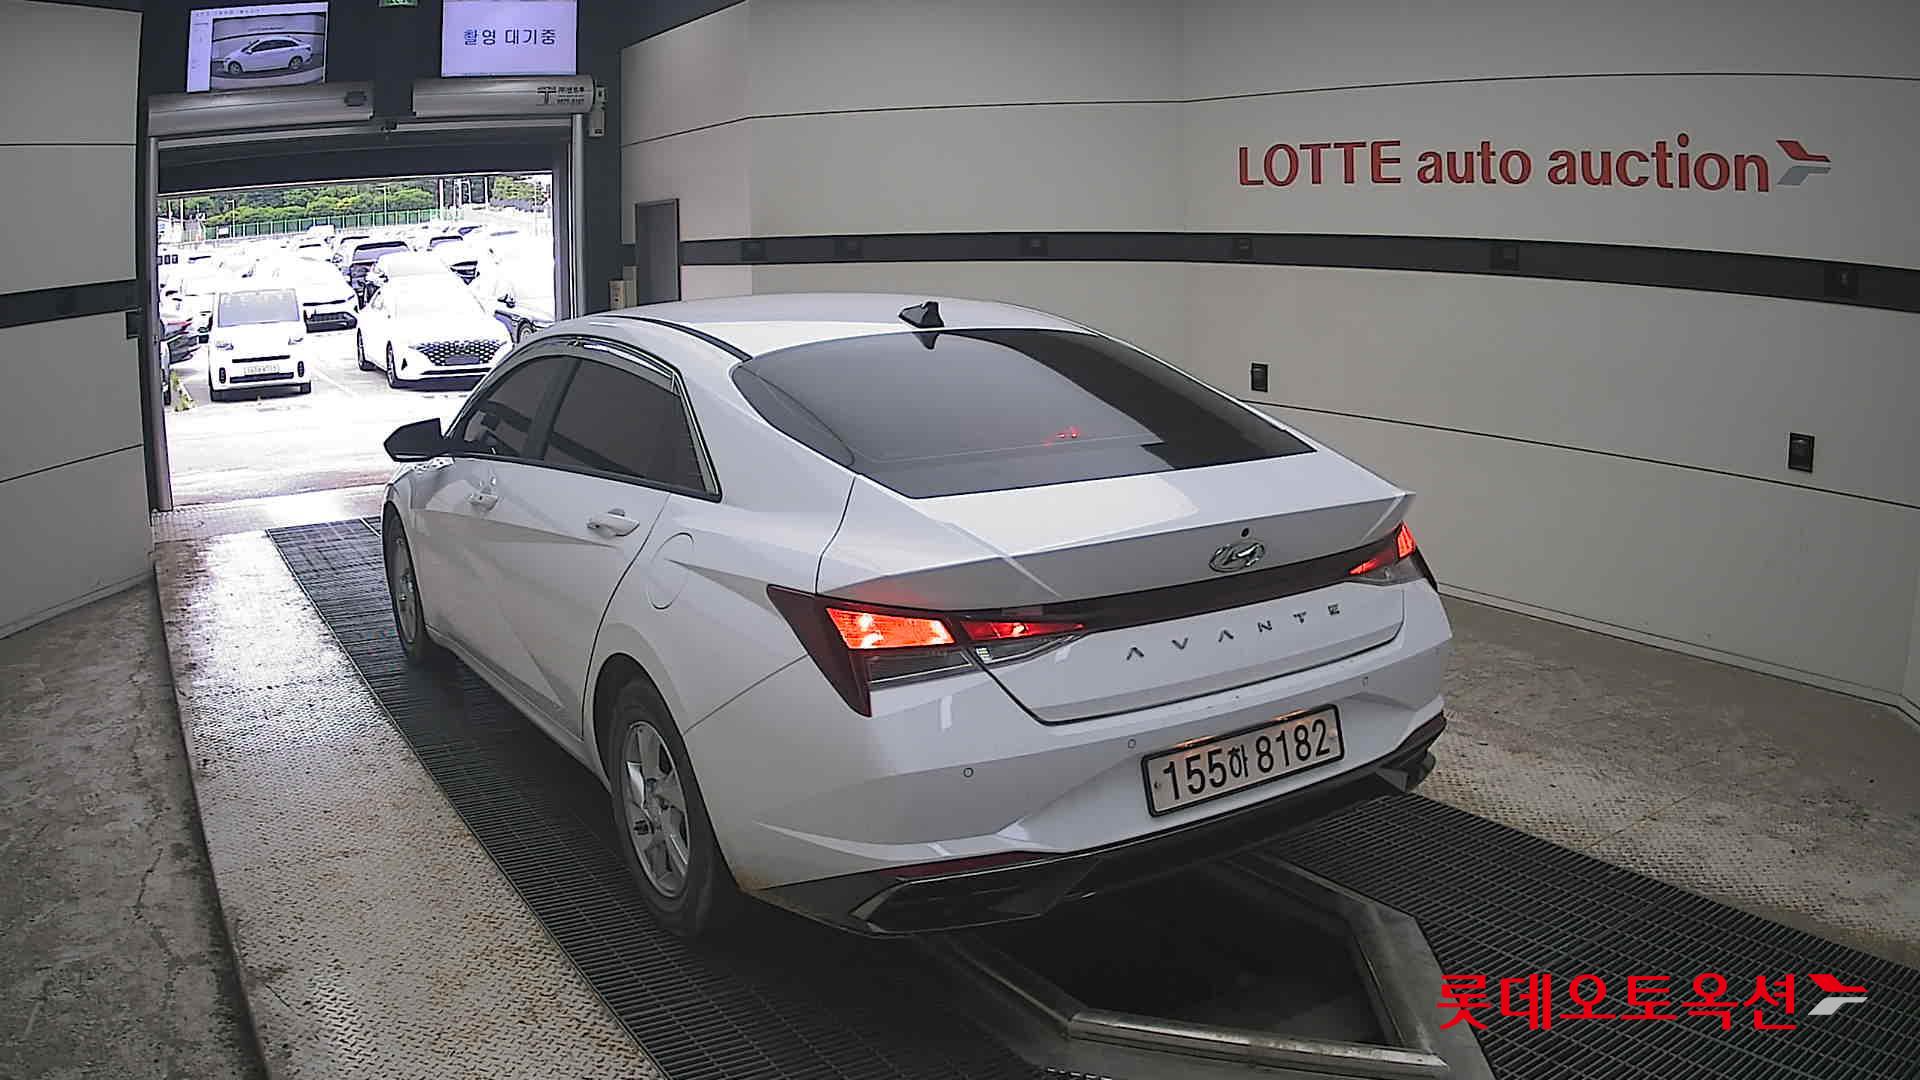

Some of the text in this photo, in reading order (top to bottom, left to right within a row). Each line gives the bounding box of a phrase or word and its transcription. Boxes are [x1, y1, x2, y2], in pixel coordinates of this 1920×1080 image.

[504, 28, 556, 45] 대기중
[1239, 134, 1769, 192] LOTTE auto auction
[1126, 603, 1341, 660] AVANTE
